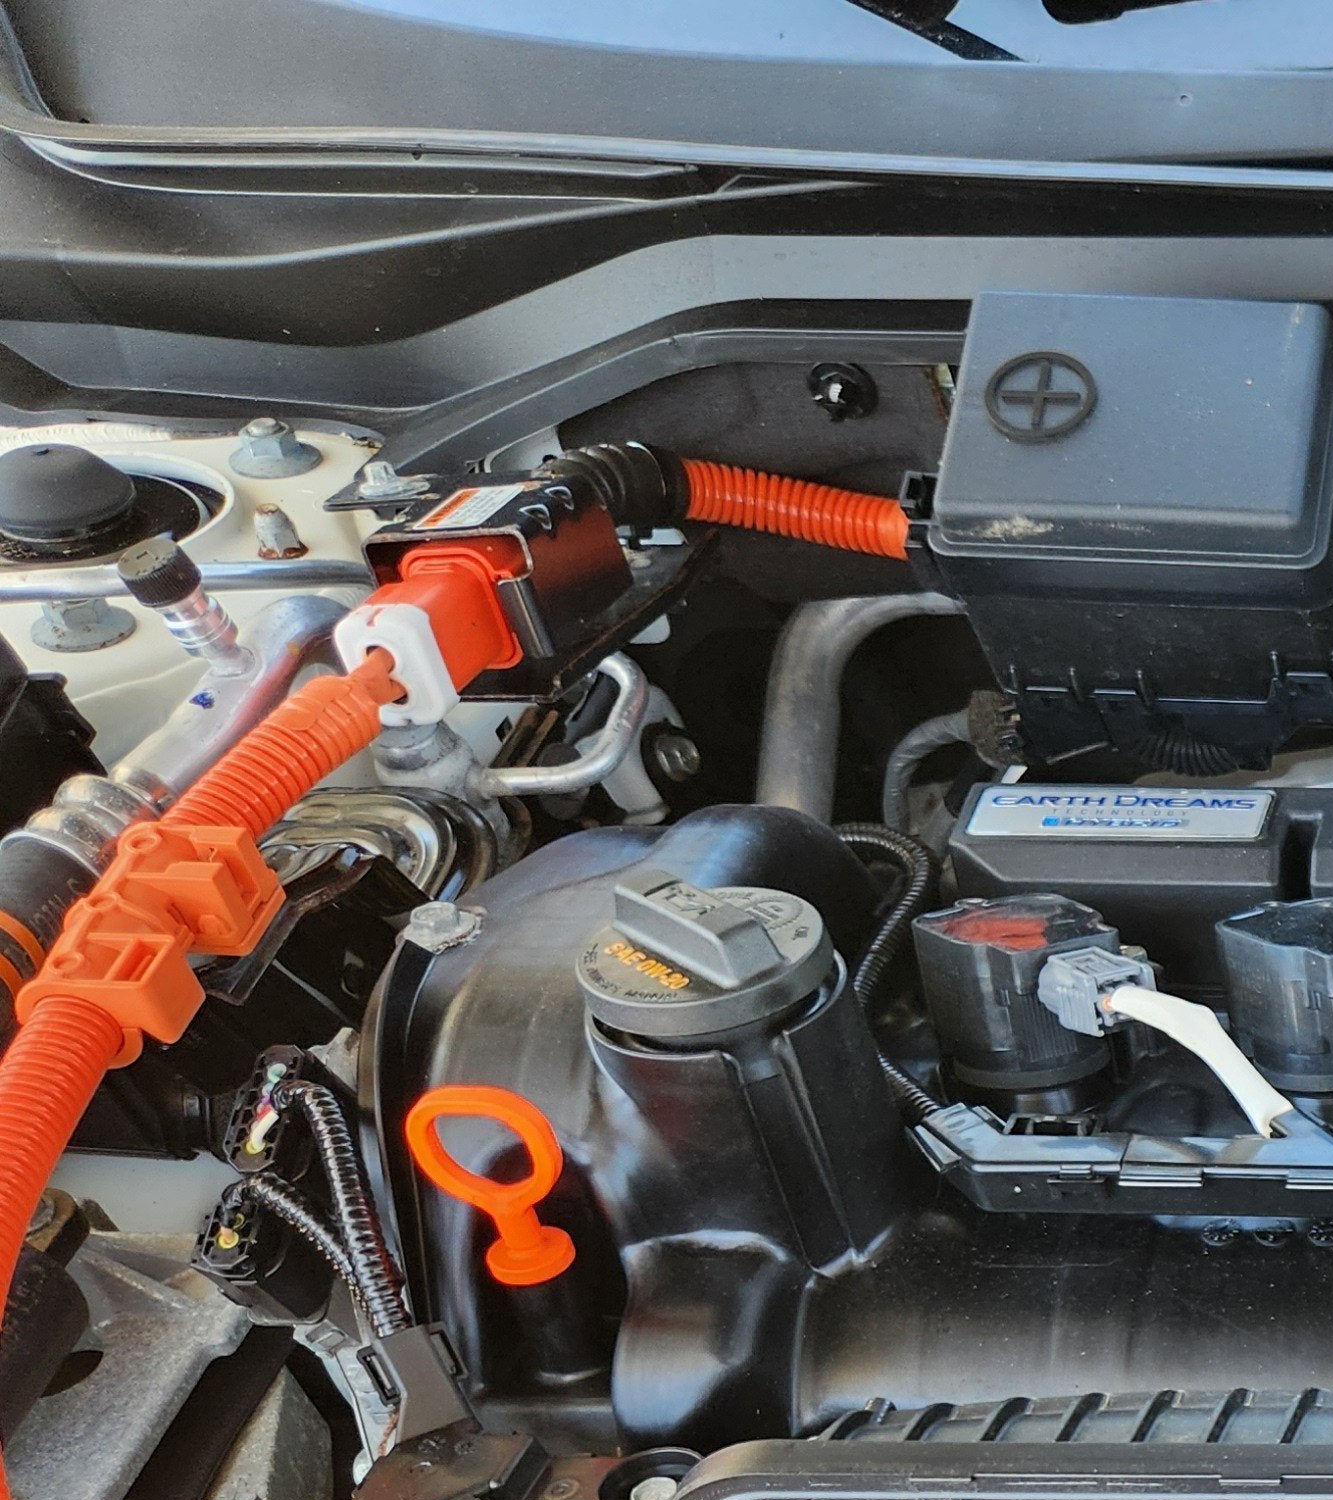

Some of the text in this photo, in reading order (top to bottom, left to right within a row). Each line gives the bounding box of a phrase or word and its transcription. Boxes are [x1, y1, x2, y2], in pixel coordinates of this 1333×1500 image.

[992, 794, 1256, 809] EARTH DREAMS
[1052, 808, 1188, 816] TECHNOLOGY
[1063, 817, 1184, 828] HYBRID
